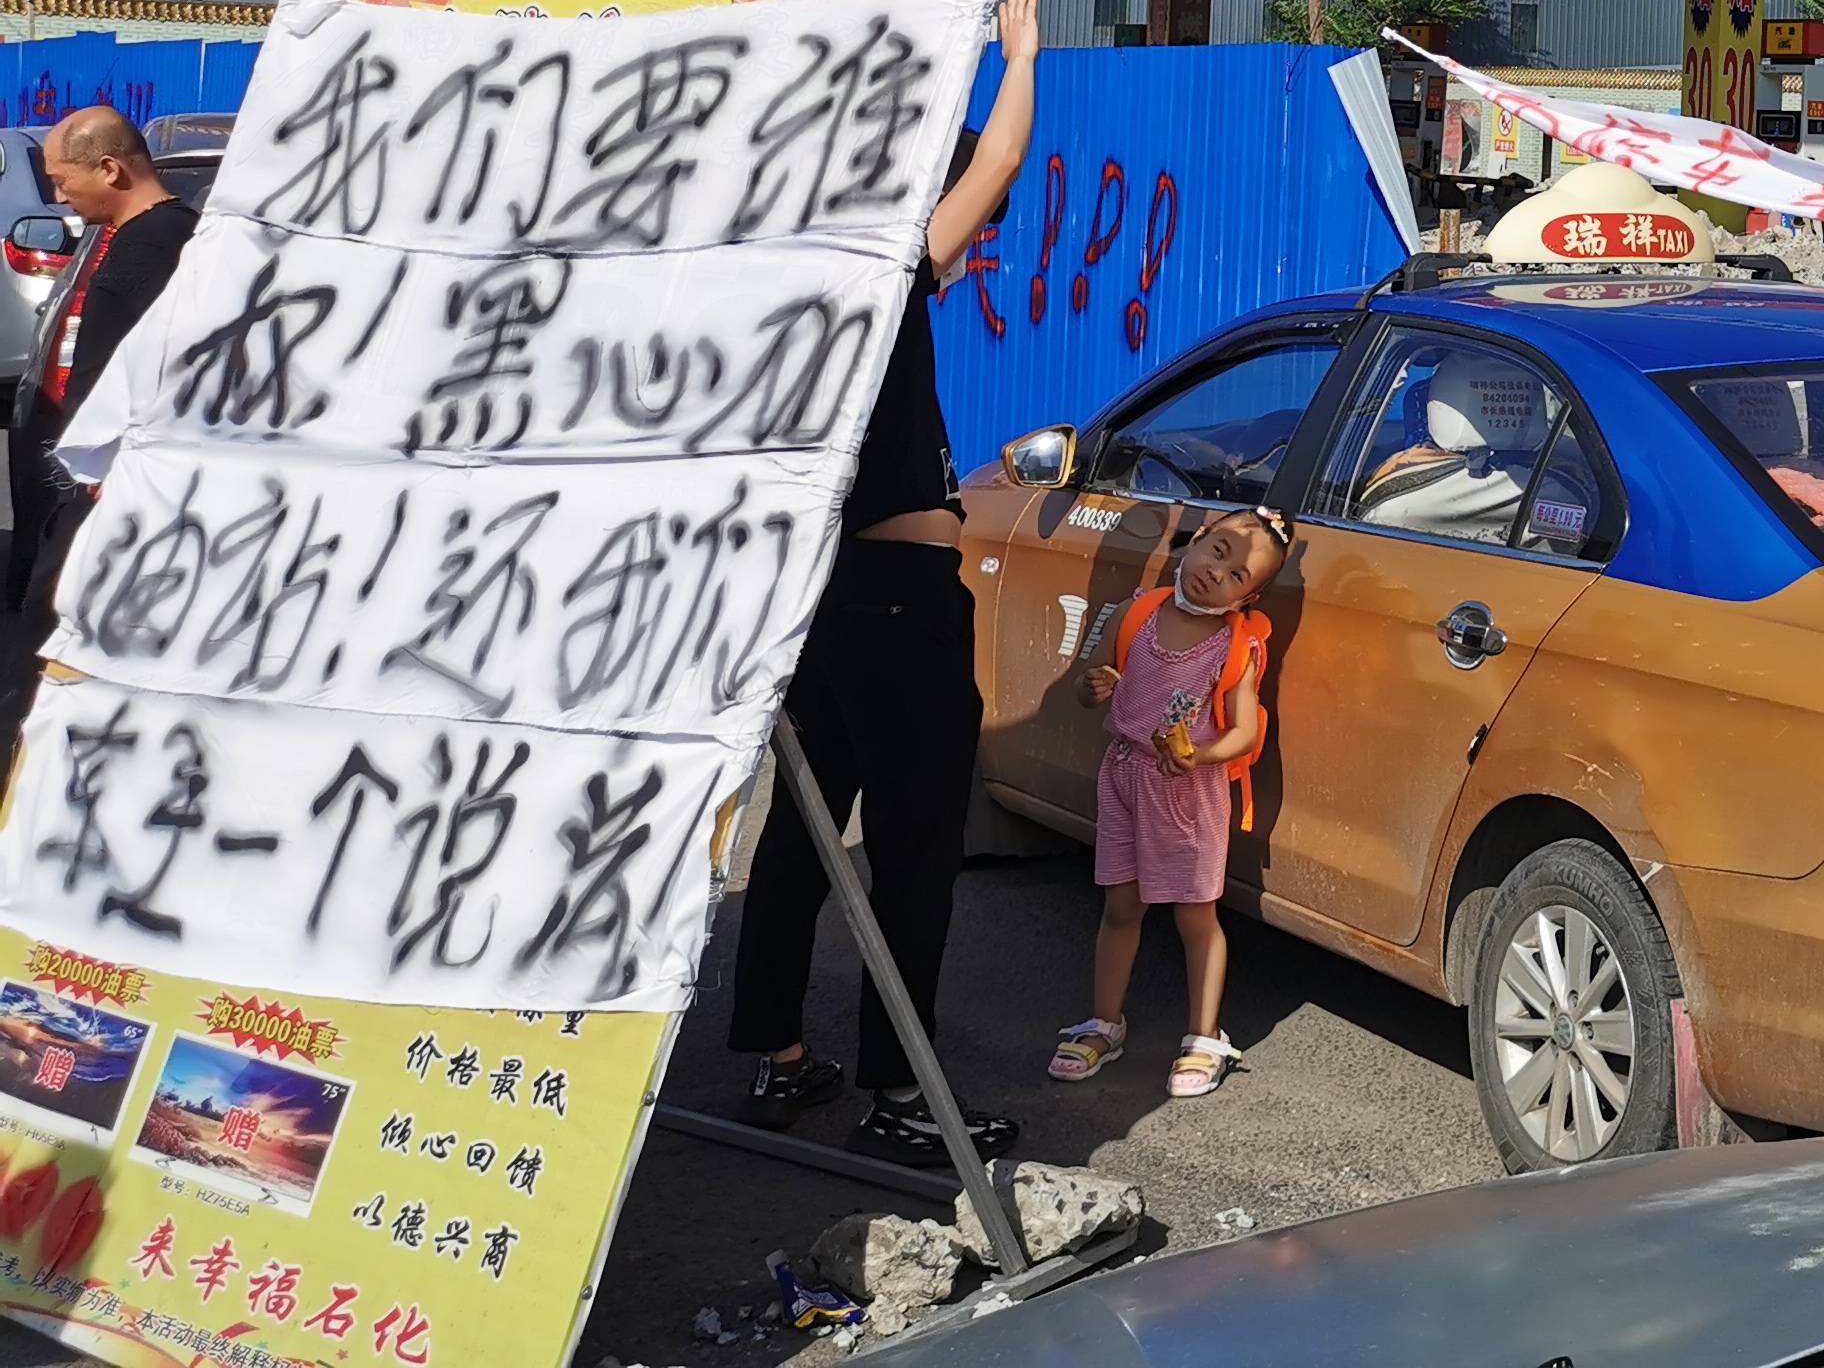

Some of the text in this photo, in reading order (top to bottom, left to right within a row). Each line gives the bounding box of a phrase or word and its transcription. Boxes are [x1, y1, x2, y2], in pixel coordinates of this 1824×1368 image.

[1657, 229, 1688, 254] TAXI
[1067, 504, 1122, 532] 400339
[30, 946, 146, 1002] 购20000油票
[207, 998, 338, 1058] 购30000油票
[36, 1048, 75, 1091] 赠
[406, 1033, 570, 1117] 价格最低
[219, 1108, 261, 1152] 赠
[380, 1113, 544, 1196] 倾心回馈
[352, 1194, 519, 1279] 以德兴商
[130, 1215, 434, 1364] 来幸福石化
